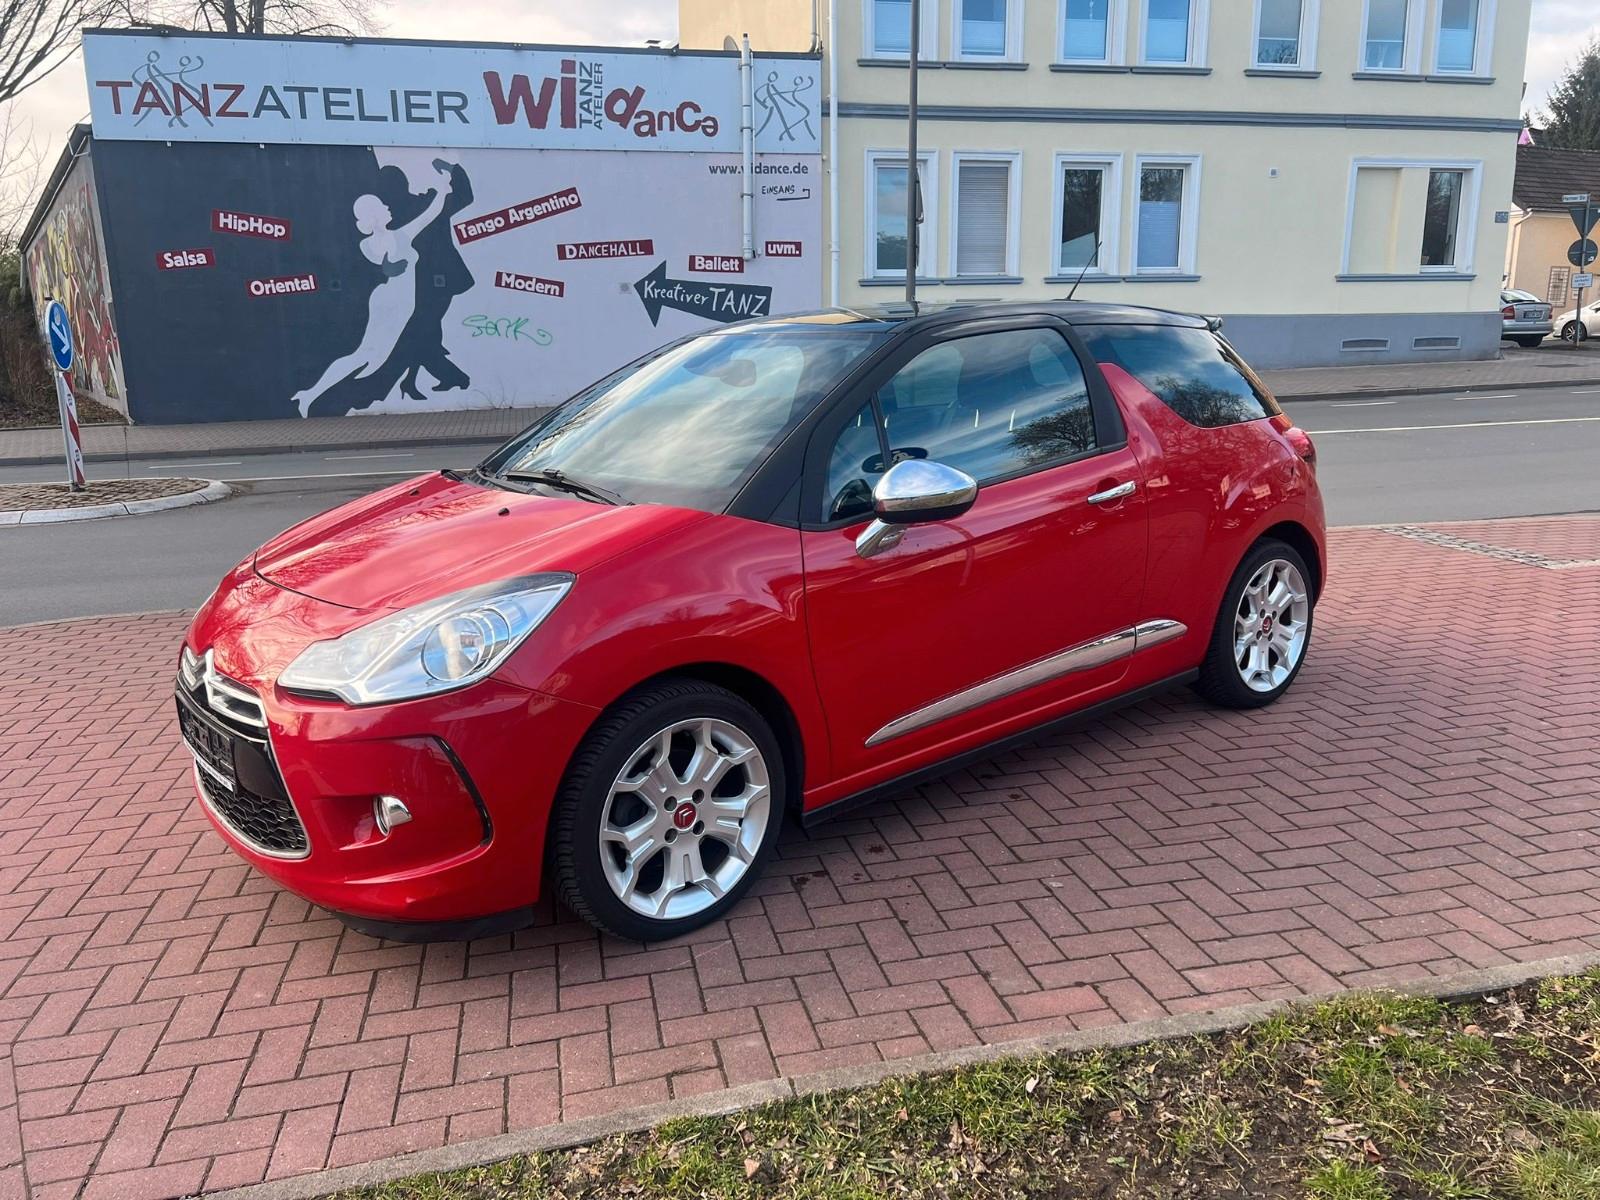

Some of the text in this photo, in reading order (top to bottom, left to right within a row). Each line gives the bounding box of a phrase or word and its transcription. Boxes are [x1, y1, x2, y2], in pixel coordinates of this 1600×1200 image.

[96, 81, 470, 124] TANZATELIER
[579, 61, 592, 128] TANZ
[594, 63, 603, 130] ATELIER
[708, 162, 808, 174] www.idance.de
[218, 212, 286, 238] HipHop
[457, 190, 579, 240] Tango Argentino
[163, 251, 207, 269] Salsa
[565, 241, 645, 259] DANCEHALL
[767, 242, 799, 255] uvm.
[694, 256, 740, 271] Ballett
[250, 275, 315, 296] Oriental
[500, 273, 560, 296] Modern
[643, 280, 767, 317] Kreativer TANZ
